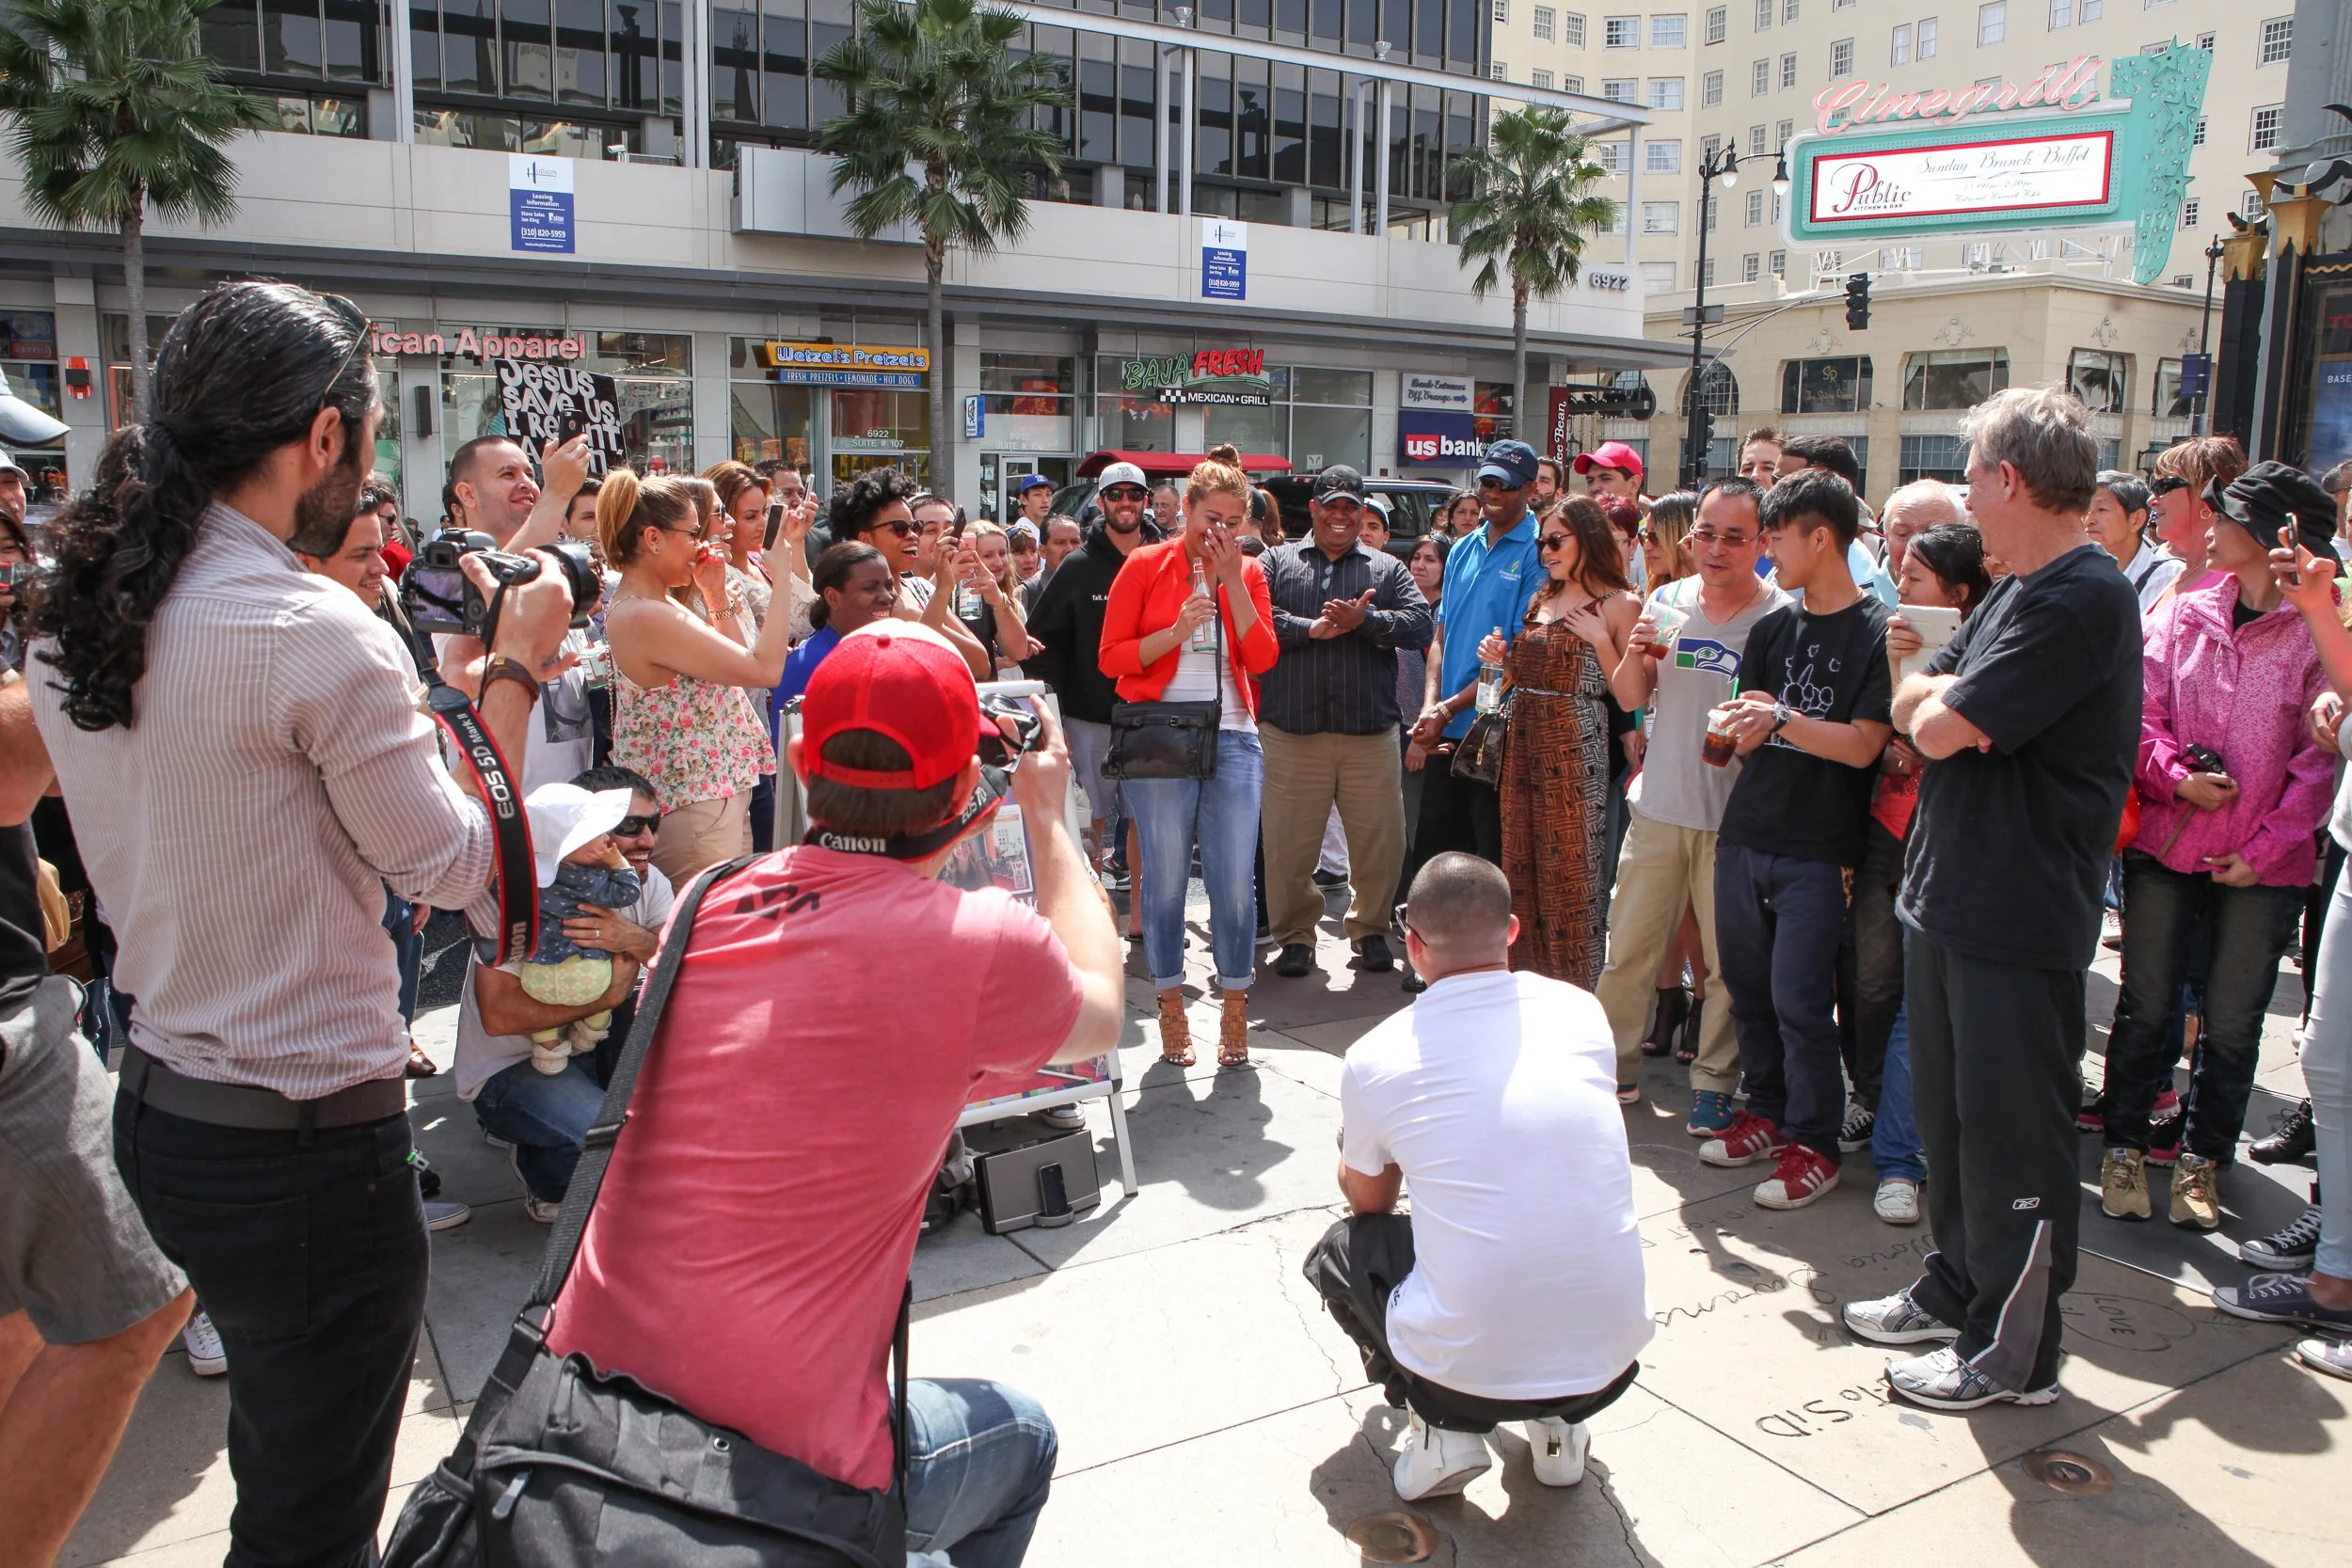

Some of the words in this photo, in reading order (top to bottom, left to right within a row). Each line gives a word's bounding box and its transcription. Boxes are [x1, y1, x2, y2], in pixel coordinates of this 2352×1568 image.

[1813, 55, 2104, 135] Cinegrill
[1915, 155, 1968, 175] Sunday
[1975, 150, 2033, 169] Brunch
[2039, 145, 2090, 166] Buffet
[532, 193, 553, 201] Leasing
[1831, 163, 1912, 213] Public
[526, 198, 560, 208] Information
[521, 227, 537, 238] (310)
[537, 229, 566, 239] 820-5959
[1589, 271, 1630, 292] 6922
[371, 324, 445, 355] ican
[455, 328, 586, 361] Apparel
[777, 346, 850, 364] Wetzel's
[853, 349, 926, 368] Pretzels
[787, 372, 807, 381] FRESH
[809, 372, 838, 383] PRETZELS
[844, 373, 878, 384] LEMONADE
[883, 374, 896, 385] HOT
[898, 375, 915, 385] DOGS
[1125, 353, 1190, 389] BAJA
[1193, 348, 1264, 377] FRESH
[1410, 378, 1434, 388] Bank
[1434, 380, 1467, 390] Entrance
[1187, 392, 1234, 404] MEXICAN
[1240, 395, 1268, 405] GRILL
[504, 409, 521, 436] I
[867, 429, 889, 438] 6922
[995, 441, 1018, 450] SUITE
[1407, 438, 1437, 457] us
[1440, 435, 1484, 458] bank
[463, 719, 485, 745] Mark
[472, 745, 496, 771] 5D
[485, 769, 515, 819] EOS
[819, 832, 886, 853] Canon
